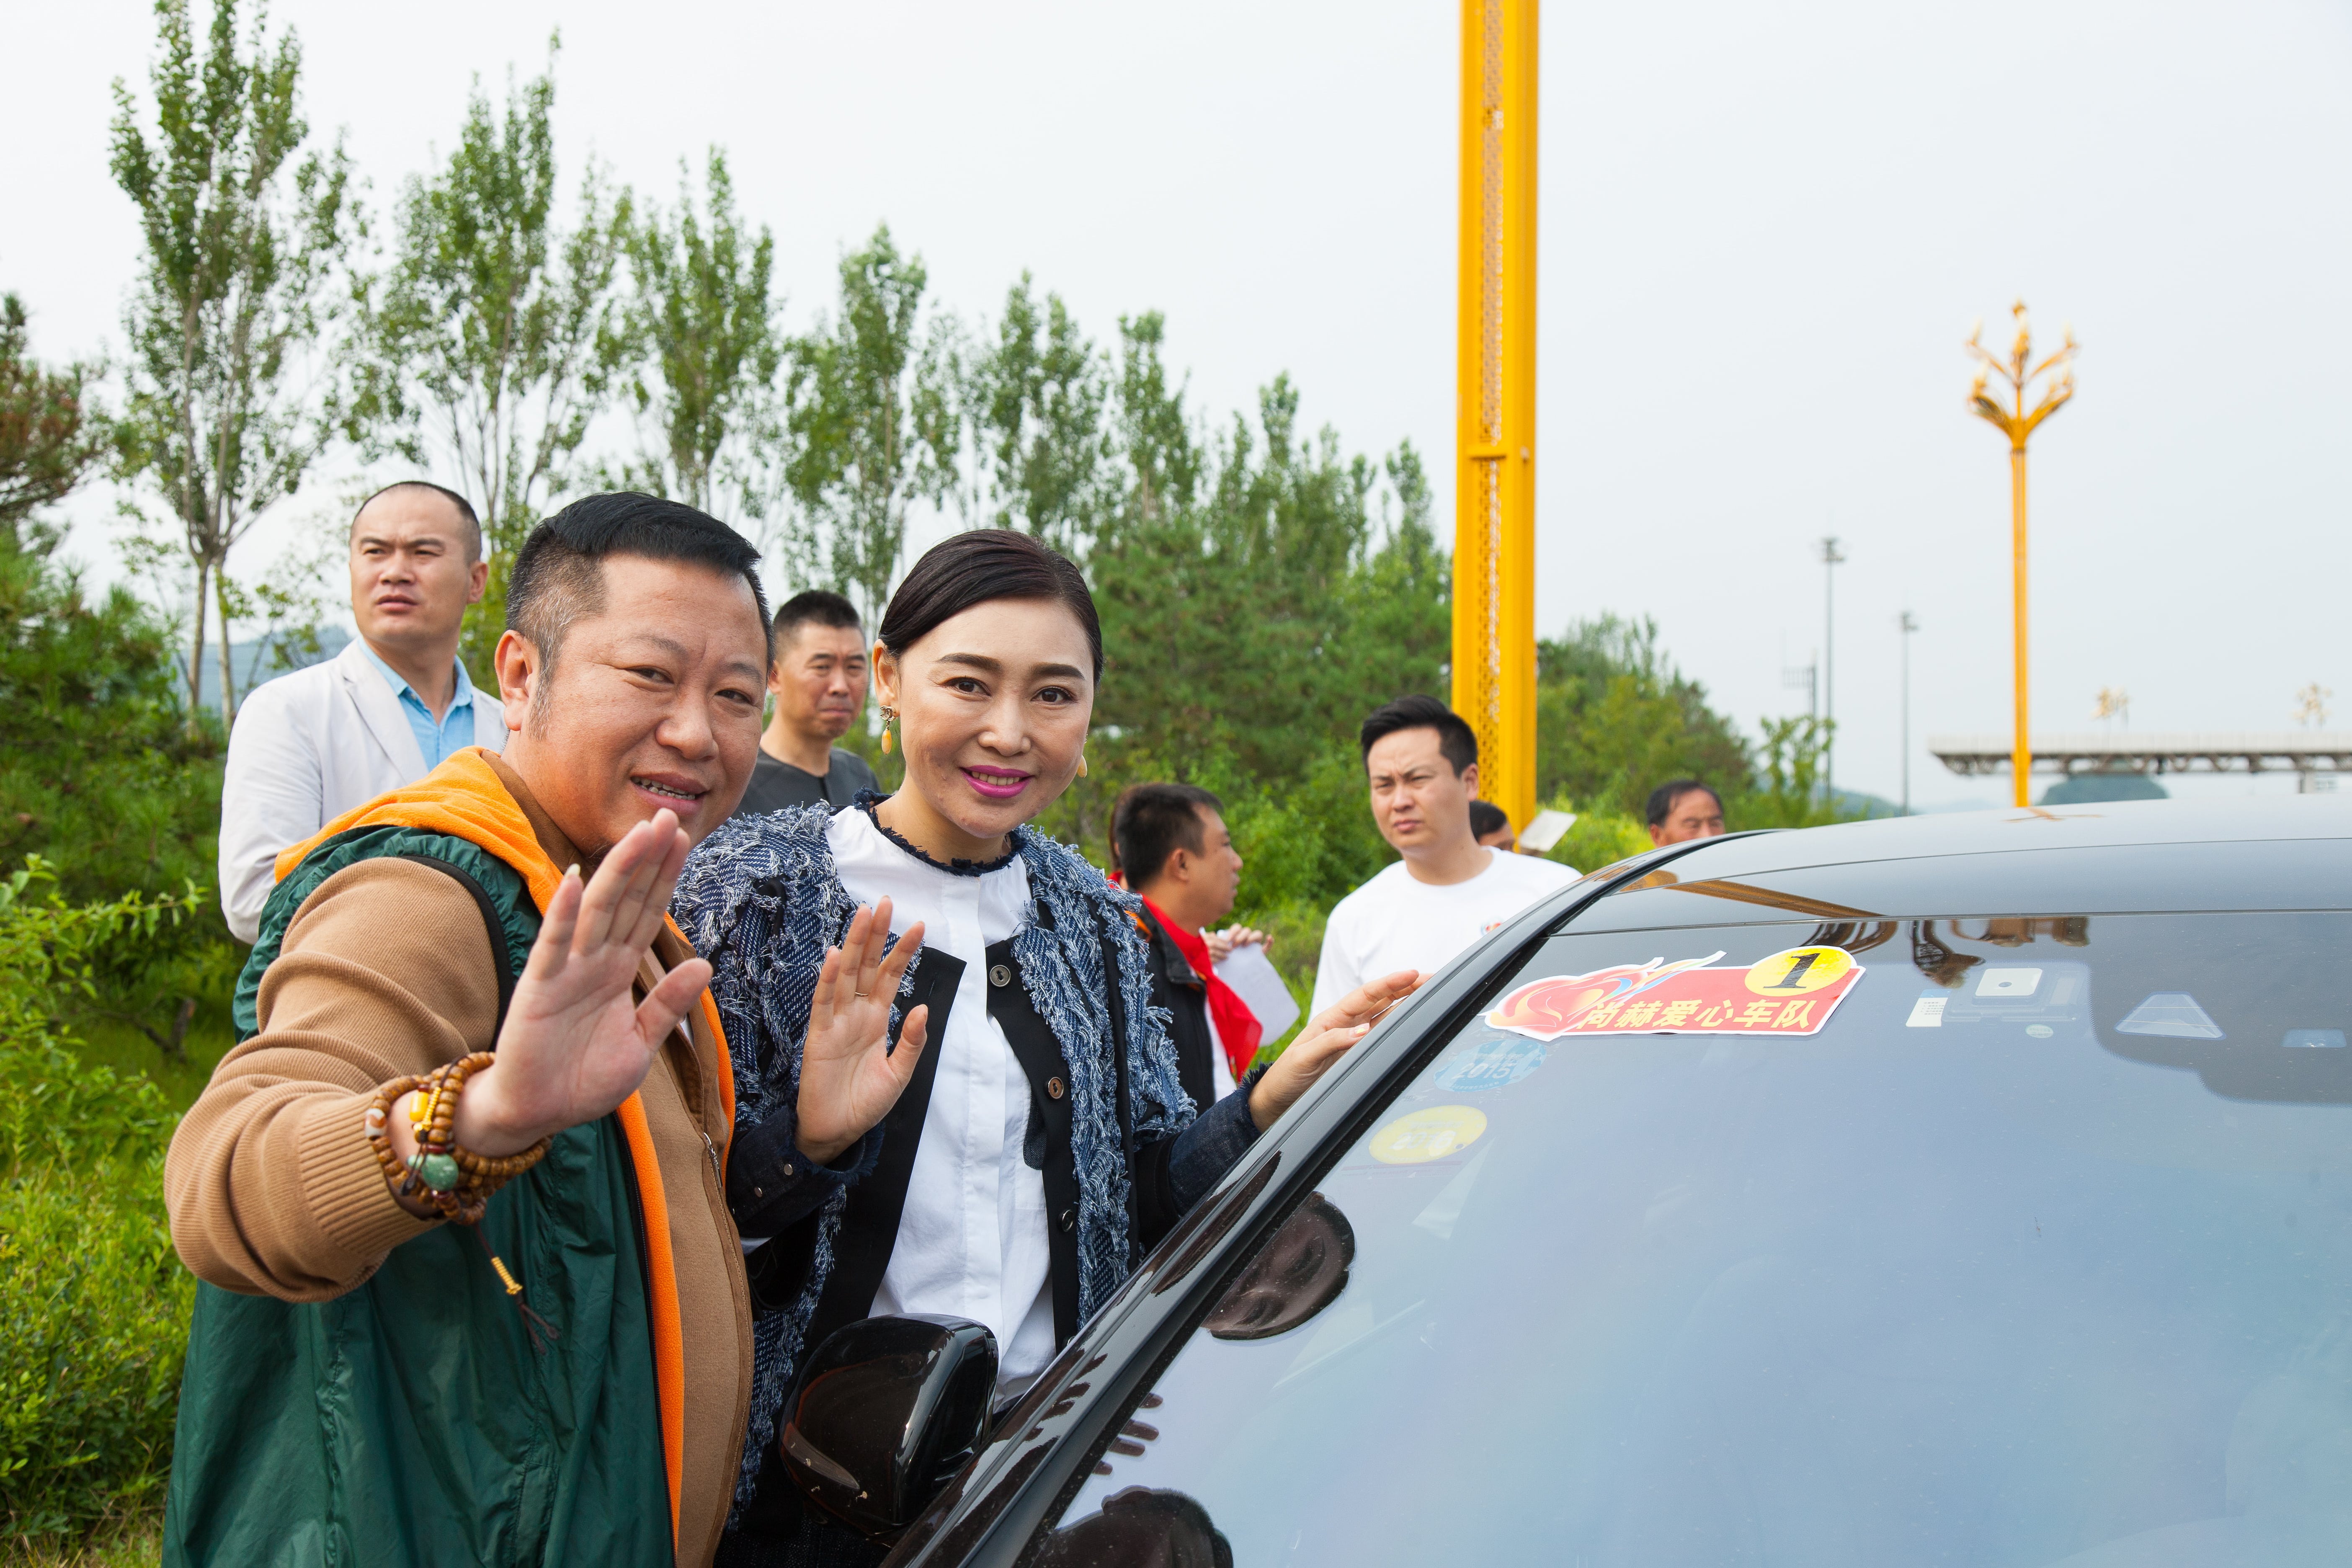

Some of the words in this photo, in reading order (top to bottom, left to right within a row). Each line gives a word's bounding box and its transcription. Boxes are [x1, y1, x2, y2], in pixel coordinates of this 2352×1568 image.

[1763, 953, 1821, 989] 1
[1577, 999, 1818, 1029] 尚赫爱心车队
[1452, 1063, 1516, 1079] 2015
[1390, 1130, 1455, 1149] 2016
